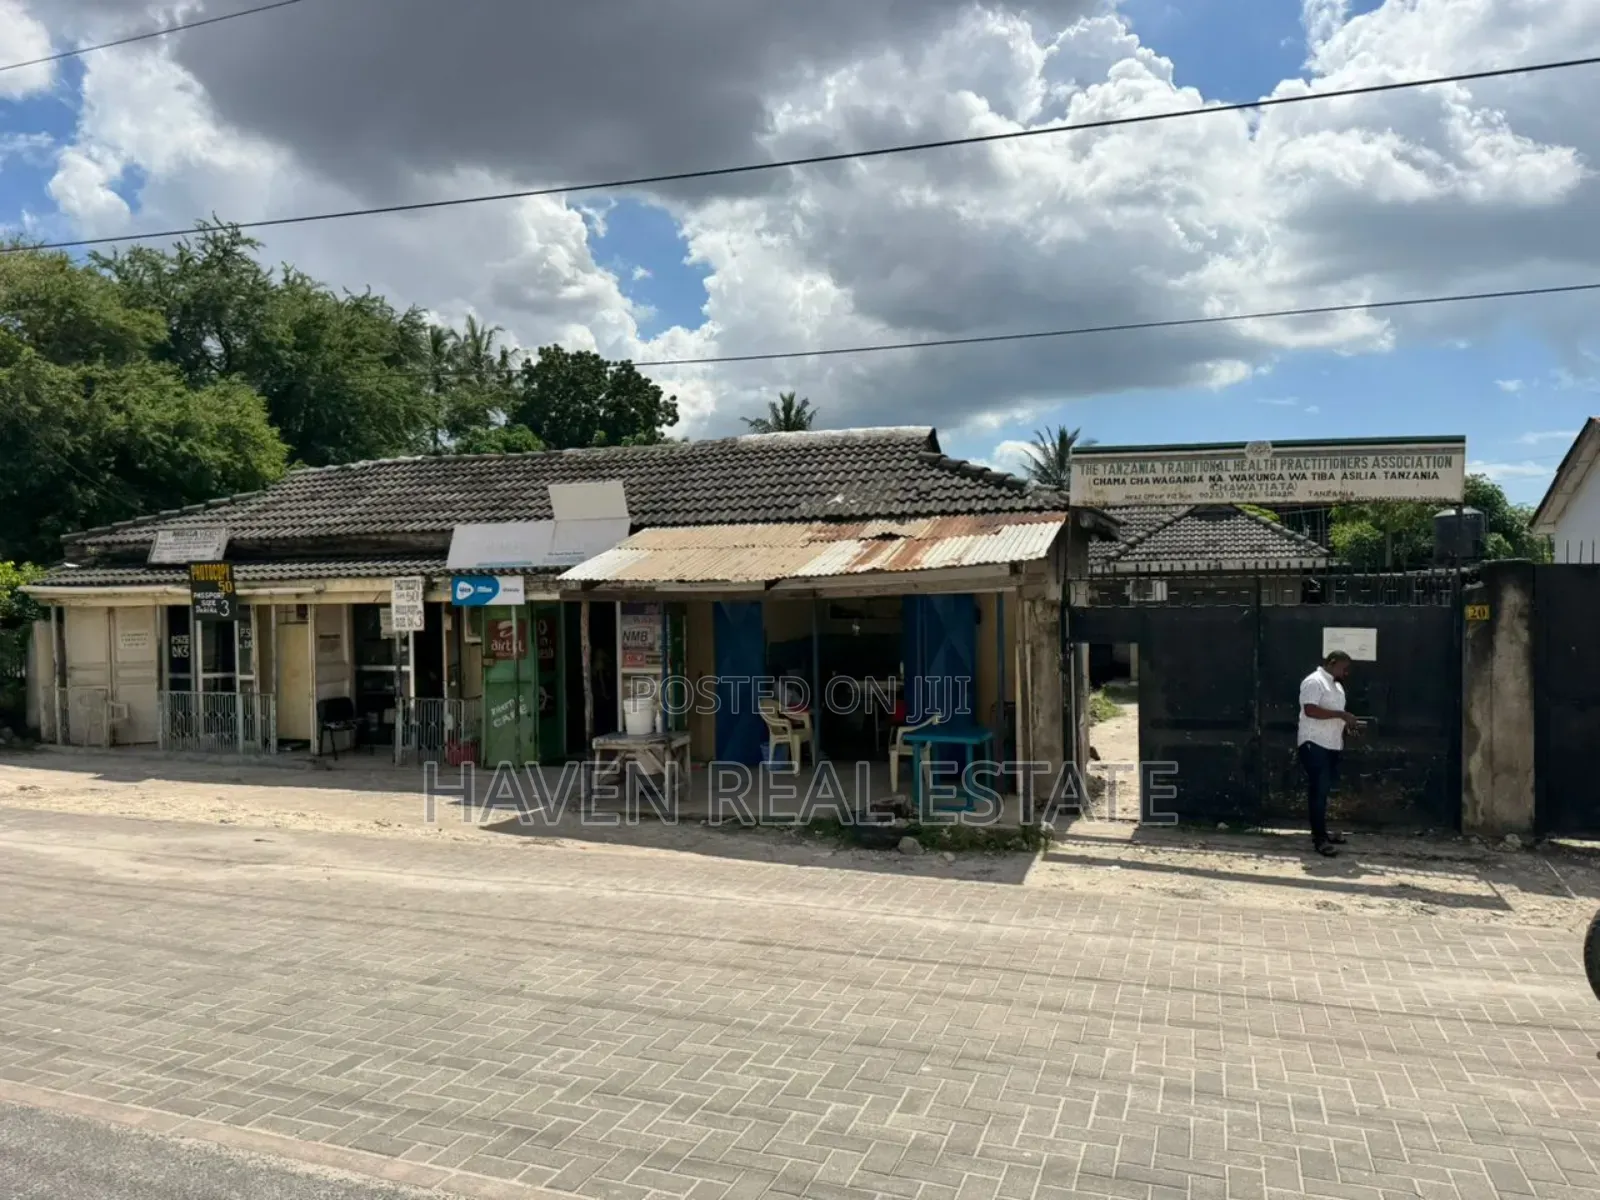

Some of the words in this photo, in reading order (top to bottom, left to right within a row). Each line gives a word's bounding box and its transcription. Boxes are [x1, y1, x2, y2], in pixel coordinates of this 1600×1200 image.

[1080, 464, 1098, 476] THE
[1103, 461, 1156, 475] TANZANIA
[1161, 460, 1230, 473] TRADITIONAL
[1234, 458, 1276, 471] HEALTH
[1280, 456, 1368, 470] PRACTITIONERS
[1371, 455, 1453, 469] ASSOCIATION
[1093, 477, 1126, 486] CHAMA
[1208, 474, 1223, 482] NA
[1228, 473, 1285, 481] WAKUNGA
[1288, 472, 1308, 481] WA
[1311, 472, 1335, 480] TIBA
[1341, 471, 1377, 480] ASILIA
[1383, 471, 1440, 480] TANZANIA
[1308, 490, 1355, 498] TANZANIA
[217, 581, 233, 593] 50
[193, 591, 225, 599] PASSPORT
[219, 600, 230, 617] 3
[1470, 606, 1488, 619] 20
[622, 630, 648, 642] NMB
